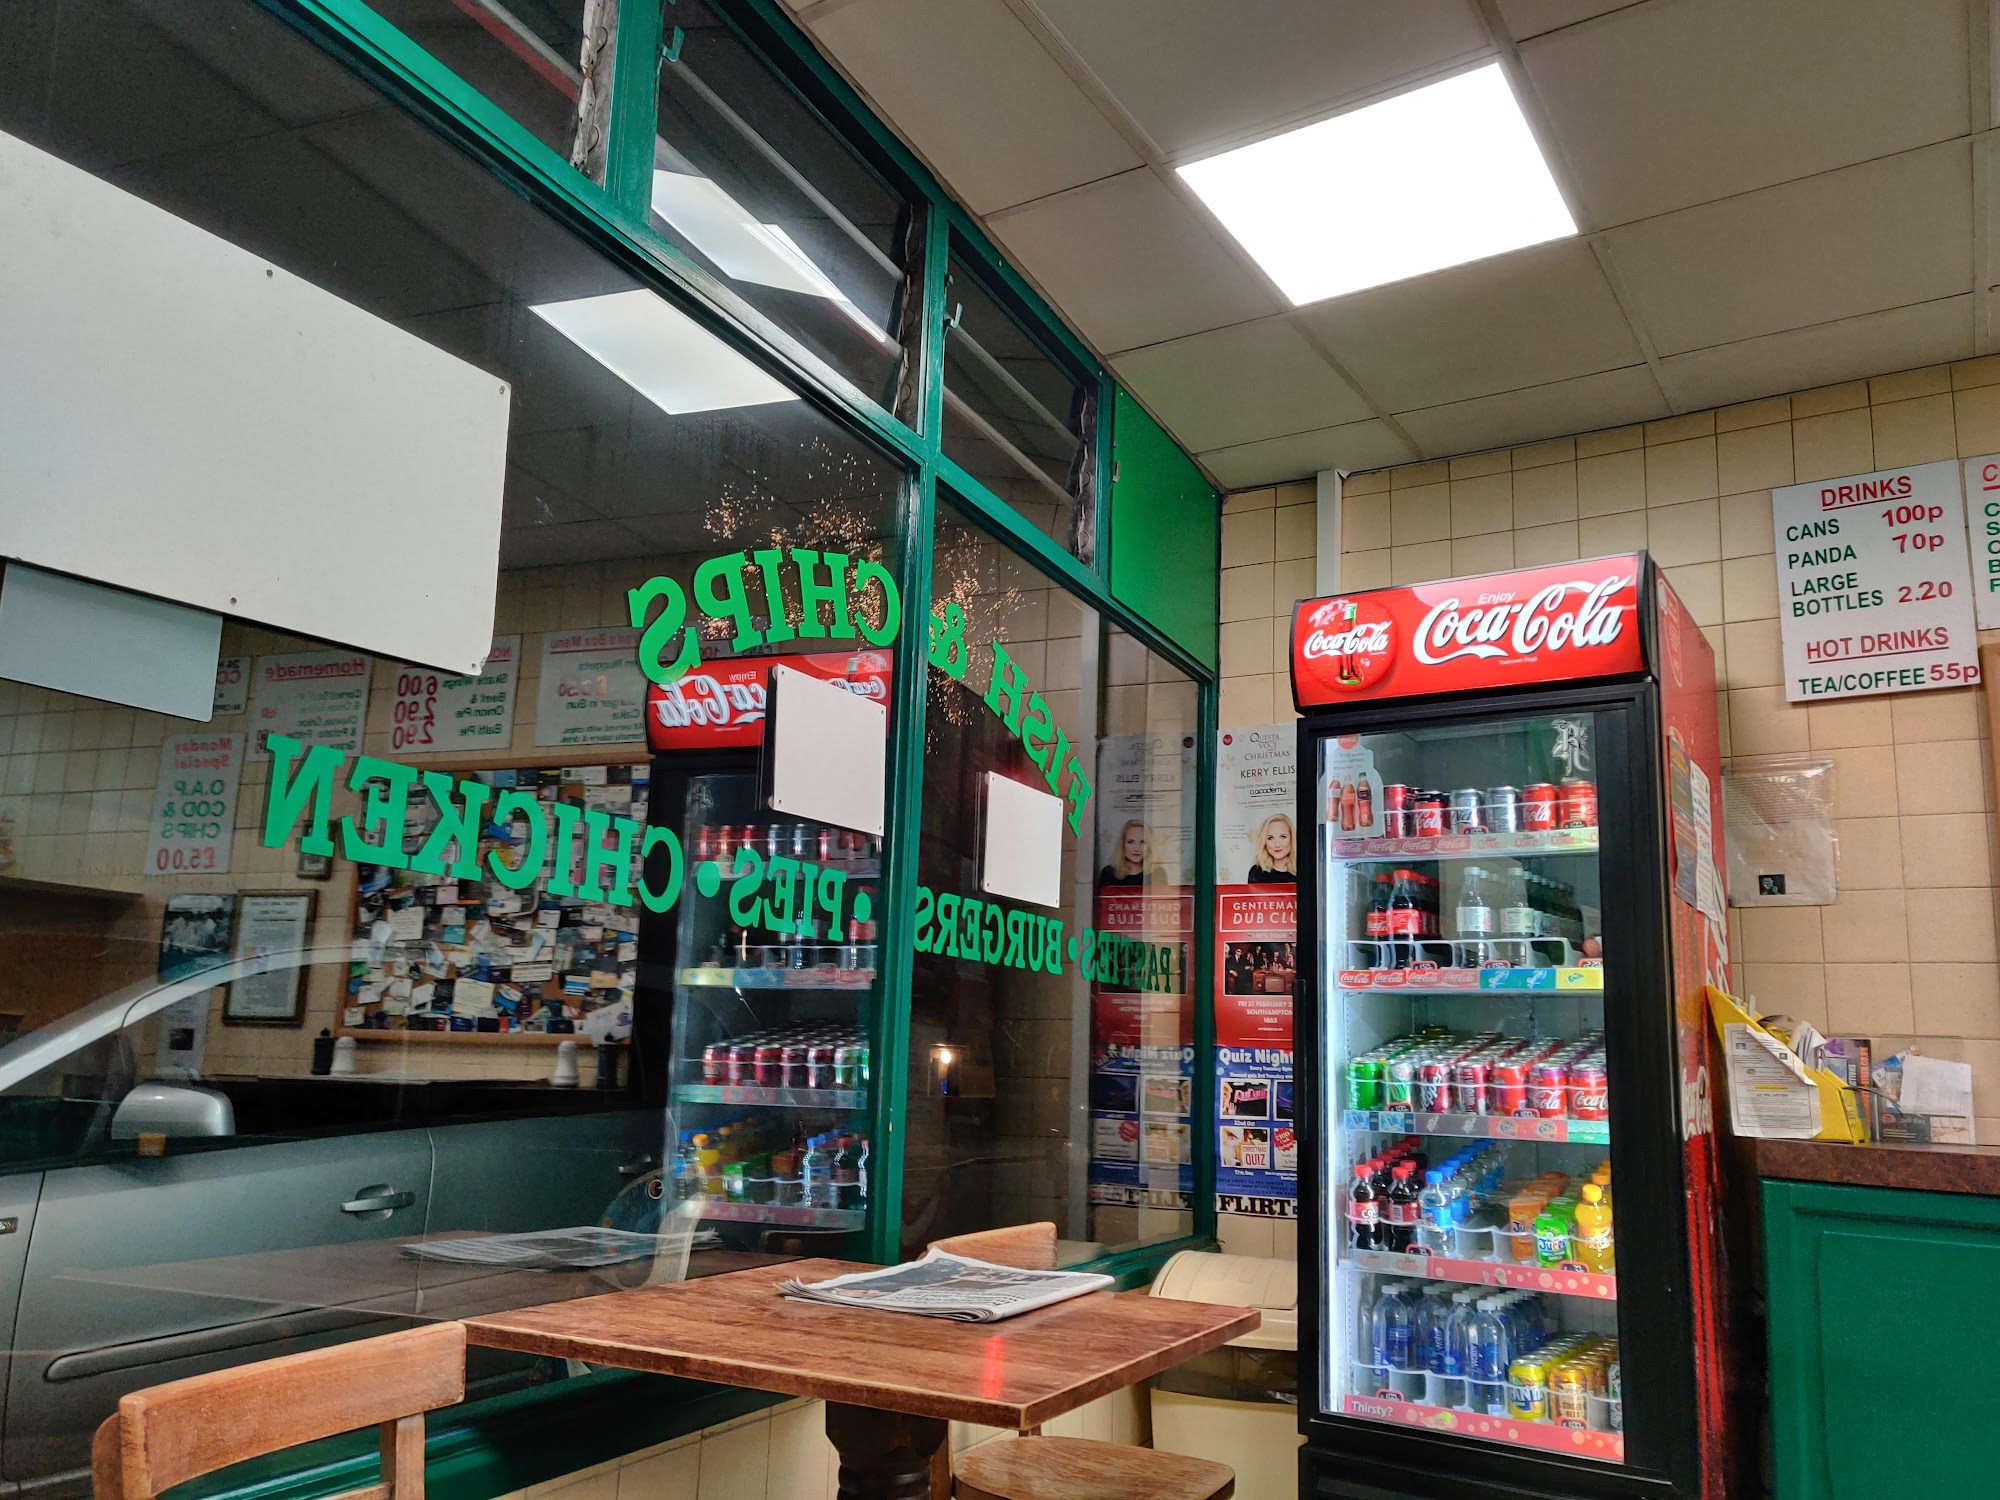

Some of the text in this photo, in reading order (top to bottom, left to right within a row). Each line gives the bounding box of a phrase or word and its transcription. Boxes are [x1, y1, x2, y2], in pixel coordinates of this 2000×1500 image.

[1820, 475, 1912, 507] DRINKS
[1786, 504, 1944, 542] CANS 100p
[1788, 533, 1945, 569] PANDA 70p
[1791, 572, 1859, 596] LARGE
[1477, 590, 1516, 606] Enjoy
[1793, 581, 1953, 617] BOTTLES 2.20
[1413, 575, 1632, 665] Coca-Cola
[1303, 620, 1392, 660] Coca-Cola
[1806, 626, 1949, 659] HOT DRINKS
[1799, 663, 1979, 695] TEA/COFFEE 55p
[1244, 750, 1291, 761] CHRISTMAS
[1240, 765, 1296, 779] KERRY ELLIS
[1233, 913, 1264, 924] DUB
[1219, 1048, 1252, 1065] Quiz
[1246, 1153, 1267, 1166] QUIZ
[1219, 1195, 1290, 1216] FLIRT
[1352, 1401, 1394, 1418] Thirsty?
